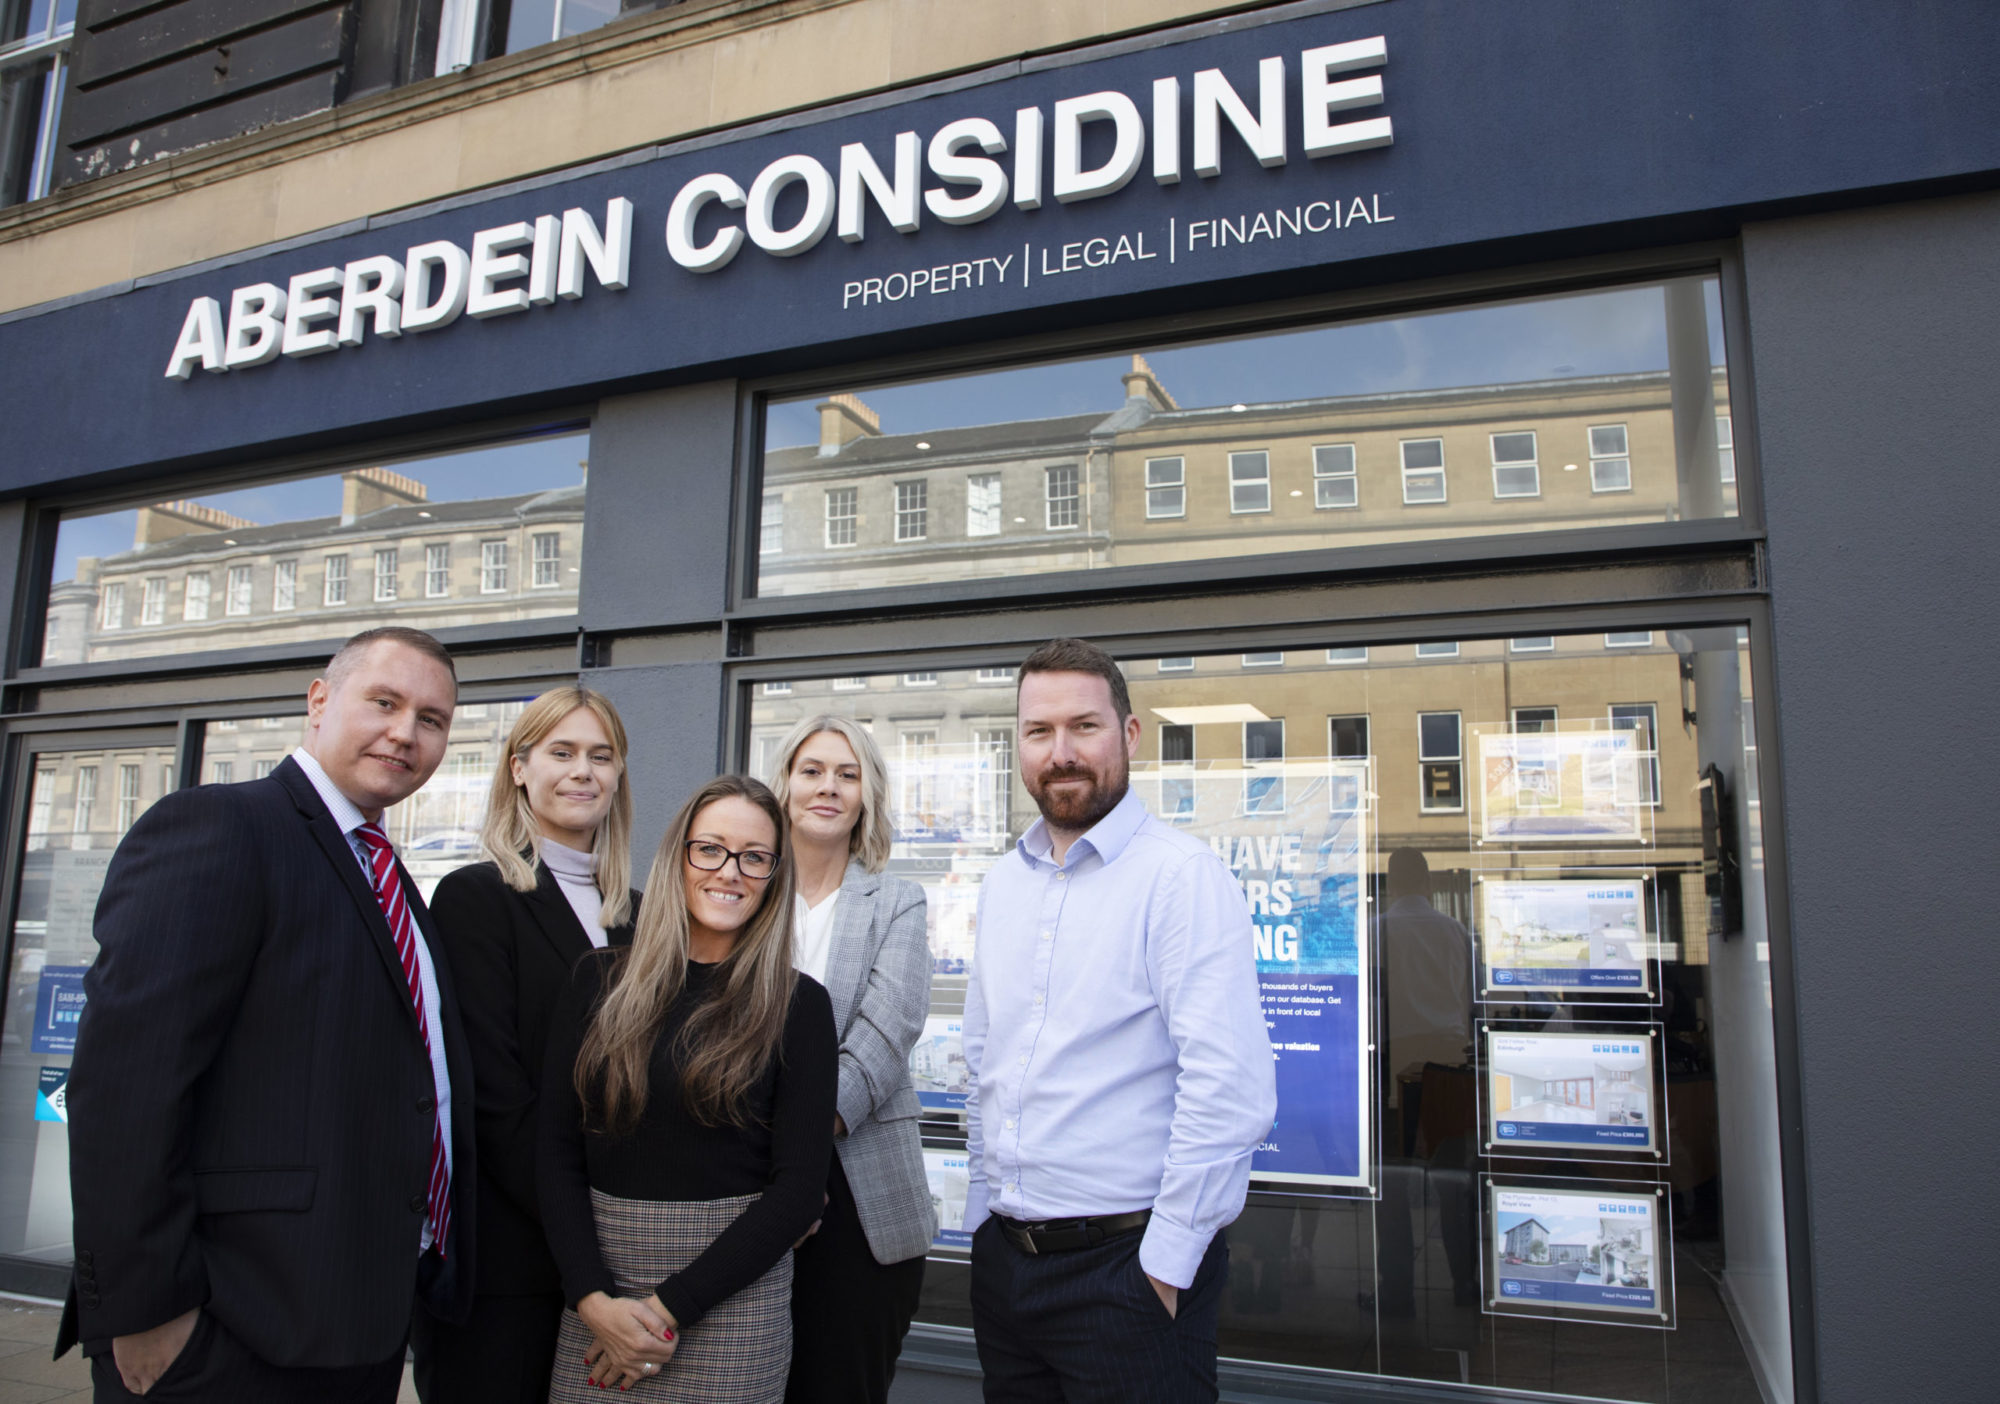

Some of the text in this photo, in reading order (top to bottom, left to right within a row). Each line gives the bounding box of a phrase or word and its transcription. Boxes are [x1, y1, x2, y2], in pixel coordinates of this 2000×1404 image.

[165, 35, 1394, 380] ABERDEIN CONSIDINE
[843, 193, 1396, 309] PROPERTY LEGAL FINANCIAL
[1487, 758, 1512, 783] SOLD
[1210, 835, 1302, 871] HAVE
[1242, 879, 1293, 917] RS
[1252, 923, 1298, 962] NG
[1261, 982, 1299, 991] thousands
[1300, 983, 1308, 991] of
[1309, 983, 1334, 993] buyers
[1291, 995, 1327, 1004] database.
[1328, 996, 1342, 1005] Get
[1268, 1007, 1276, 1015] in
[1277, 1007, 1294, 1016] front
[1295, 1008, 1303, 1016] of
[1304, 1008, 1322, 1017] local
[1271, 1042, 1320, 1052] ree valuation
[1257, 1142, 1281, 1152] CIAL
